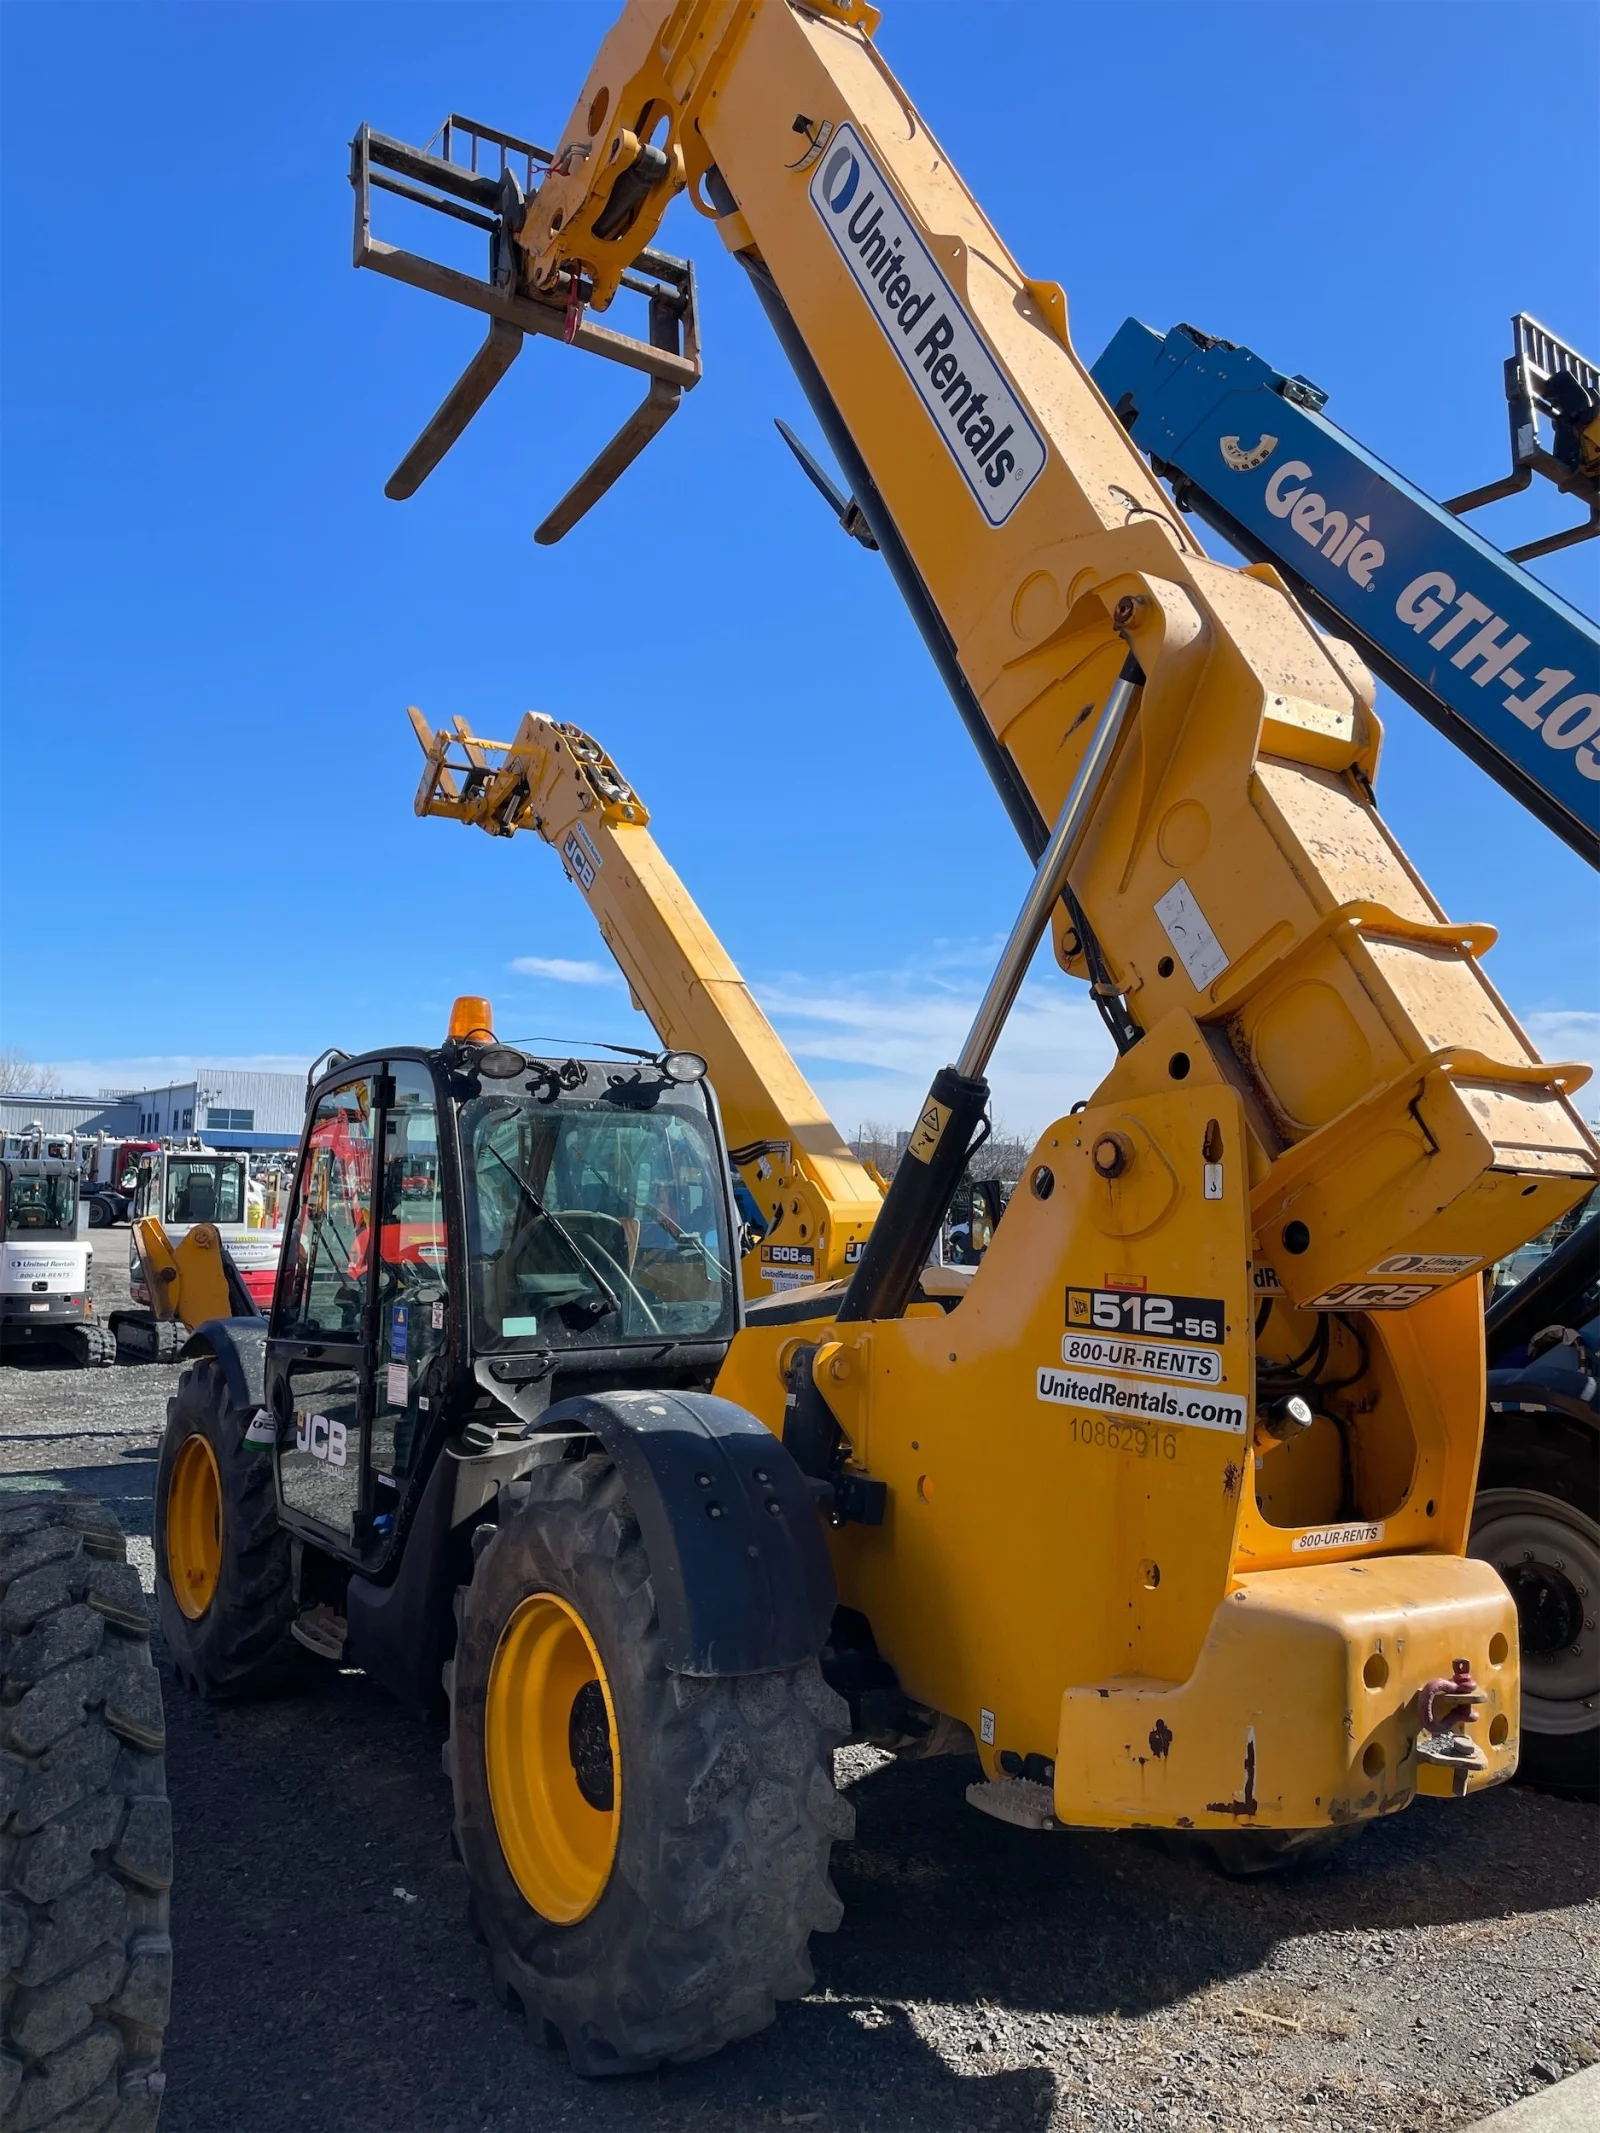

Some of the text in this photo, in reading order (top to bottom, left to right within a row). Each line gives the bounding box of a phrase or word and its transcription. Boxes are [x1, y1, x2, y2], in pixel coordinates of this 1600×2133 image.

[847, 191, 1016, 489] United Rentals
[1265, 460, 1385, 590] Genie
[564, 834, 596, 890] JCB
[761, 1269, 814, 1281] UnitedRentals.com
[1423, 1257, 1475, 1266] United
[1092, 1293, 1217, 1339] 512-56
[1312, 1283, 1434, 1306] JCB
[1068, 1341, 1214, 1376] 800-UR-RENTS
[1039, 1373, 1243, 1426] UnitedRentals.com
[296, 1409, 347, 1467] JCB
[1069, 1417, 1177, 1460] 10862916
[1299, 1527, 1378, 1548] 800-UR-RENTS
